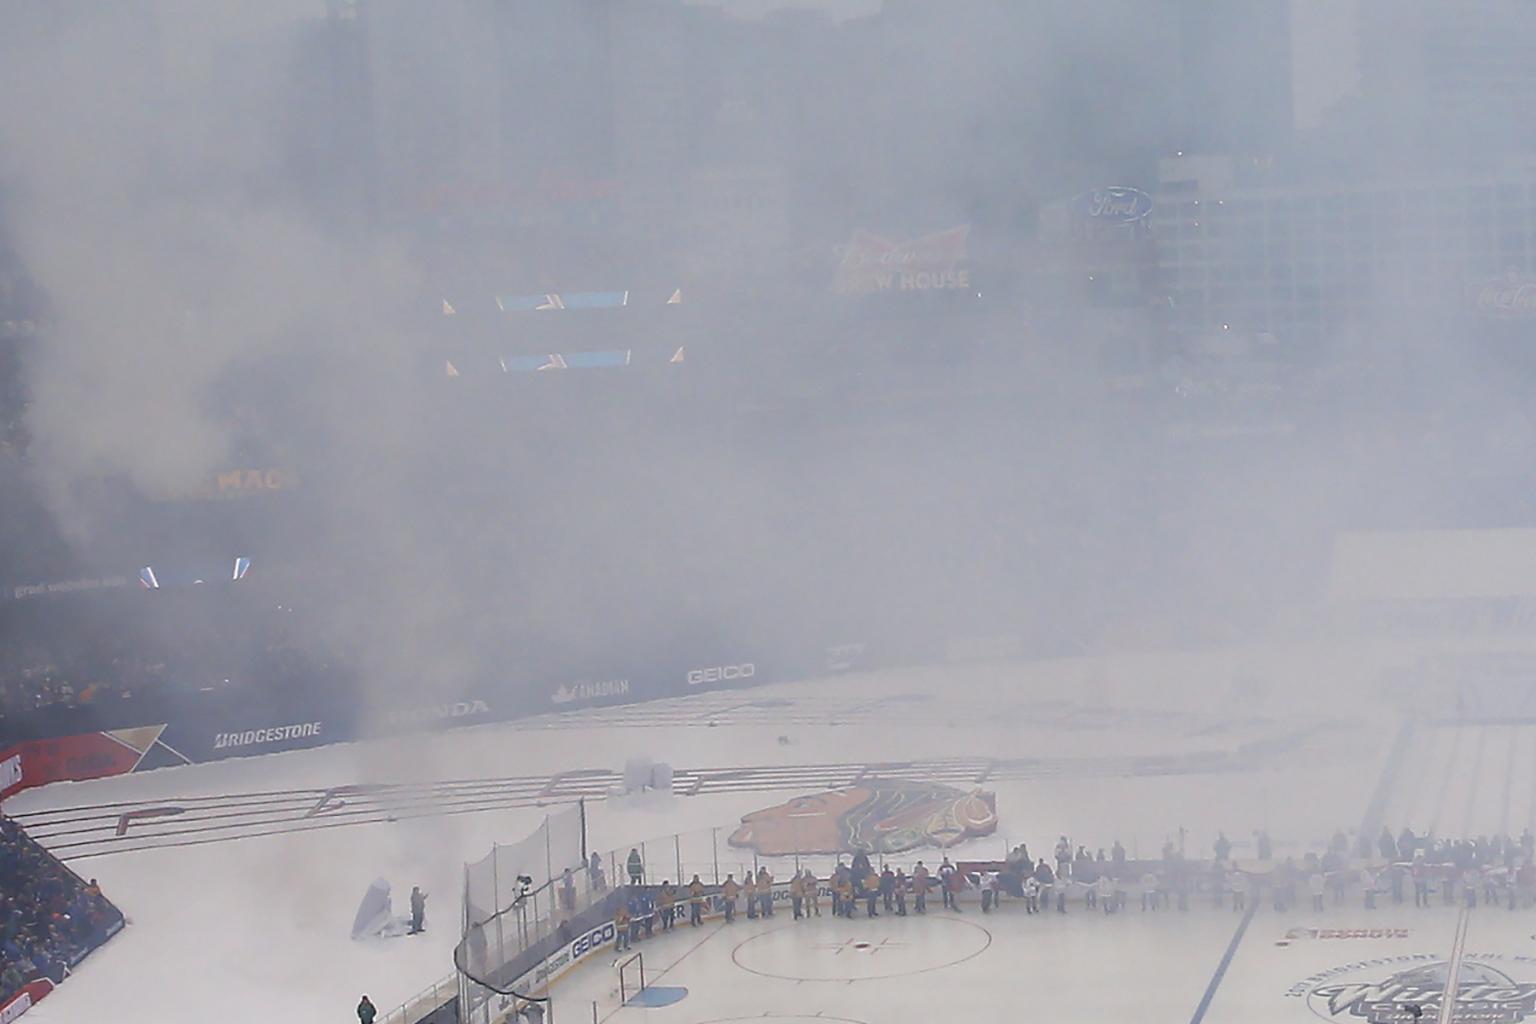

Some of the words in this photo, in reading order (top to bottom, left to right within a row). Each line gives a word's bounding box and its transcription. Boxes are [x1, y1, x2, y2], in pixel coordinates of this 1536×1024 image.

[686, 662, 756, 684] GEICO
[215, 721, 321, 748] BRIDGESTONE
[571, 919, 615, 958] GEICO
